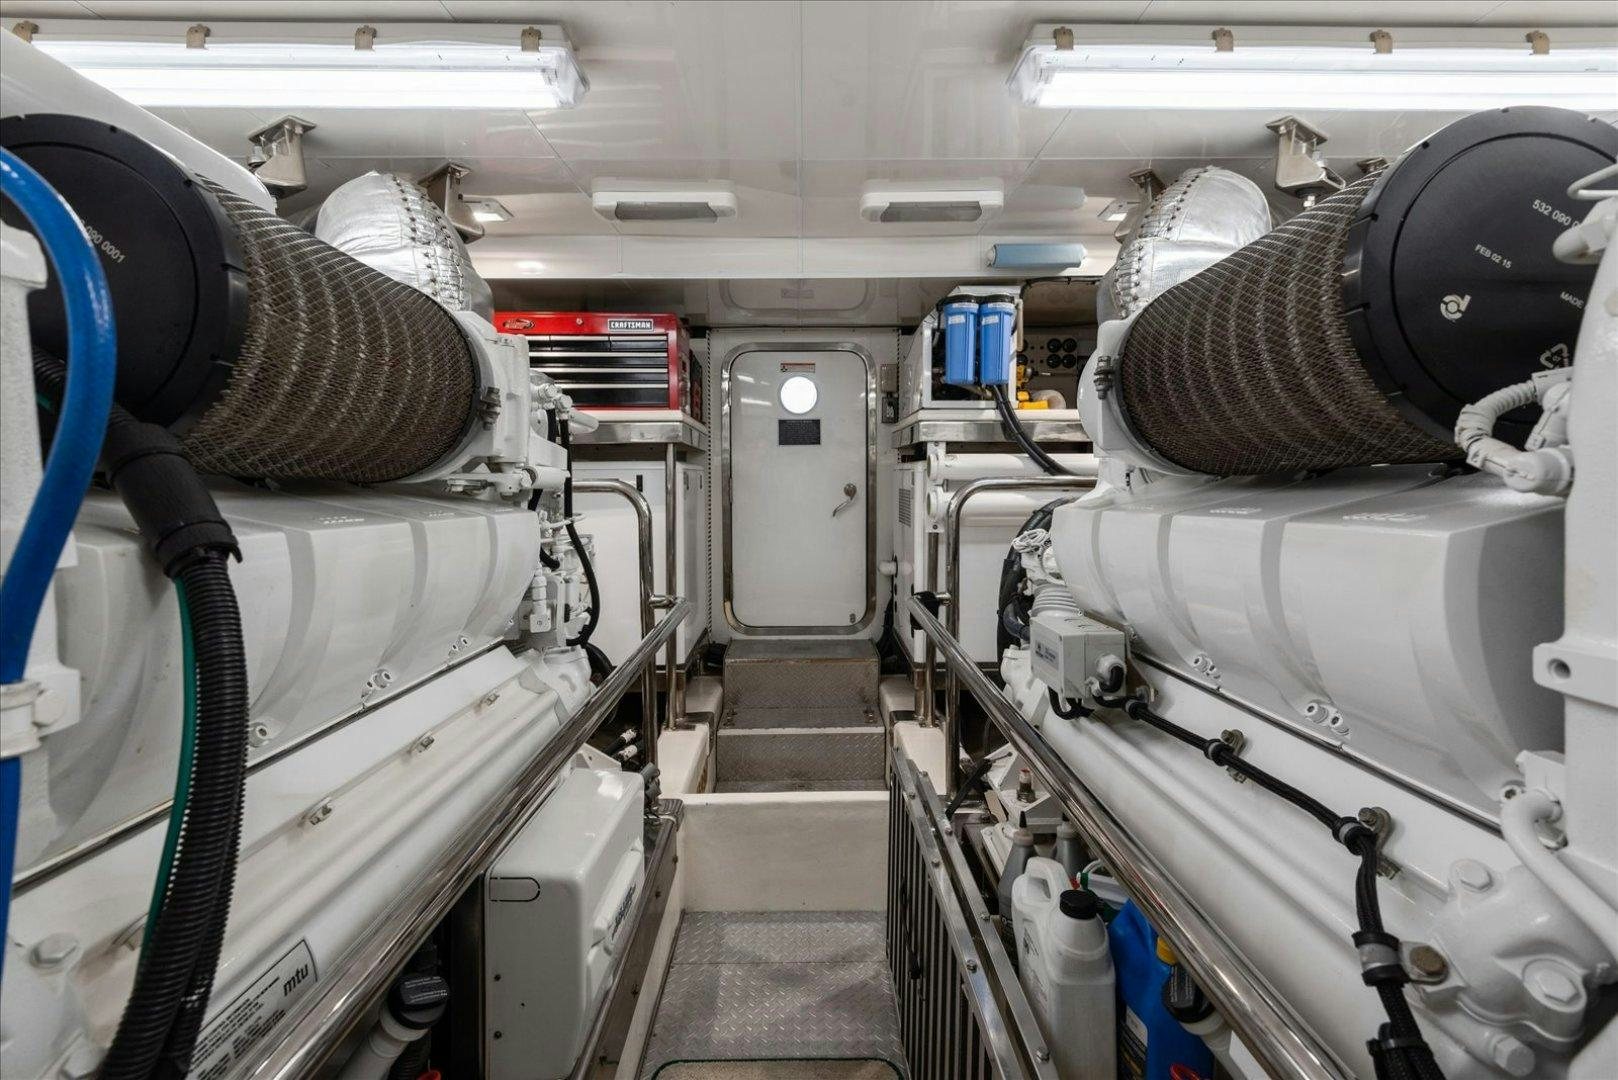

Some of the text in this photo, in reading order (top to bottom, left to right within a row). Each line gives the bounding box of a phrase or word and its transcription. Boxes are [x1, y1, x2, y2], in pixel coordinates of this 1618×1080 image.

[1532, 199, 1552, 216] 532
[1551, 210, 1572, 226] 090
[101, 241, 126, 263] 0001
[1474, 243, 1513, 269] FEB 02 15
[1559, 291, 1585, 309] MADE
[610, 321, 651, 329] CRAFTSMAN
[282, 963, 309, 997] mtu
